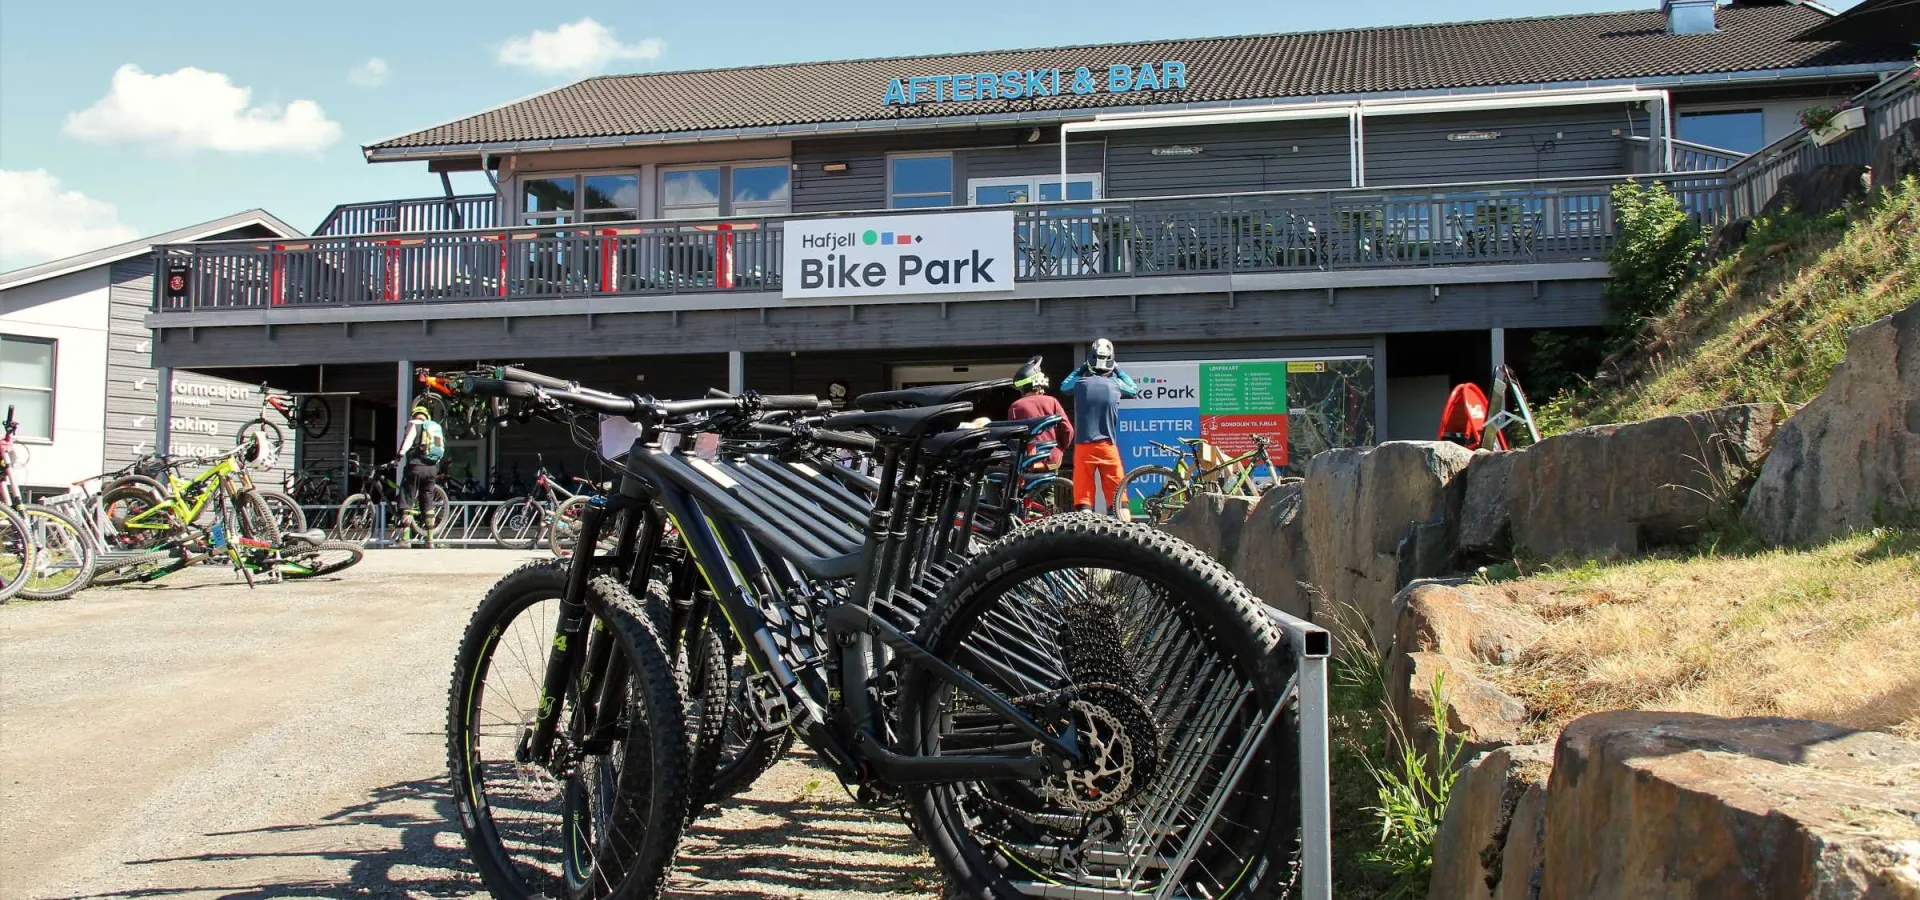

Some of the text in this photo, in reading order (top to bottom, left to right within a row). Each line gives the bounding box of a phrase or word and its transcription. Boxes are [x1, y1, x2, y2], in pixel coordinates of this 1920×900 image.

[883, 60, 1186, 106] AFTERSKI & BAR
[802, 232, 856, 251] Hafjell
[800, 249, 995, 289] Bike Park
[171, 379, 250, 402] formasjon
[1157, 385, 1195, 399] Park
[1119, 419, 1193, 432] BILLETTER
[926, 560, 1017, 652] CHWALBE
